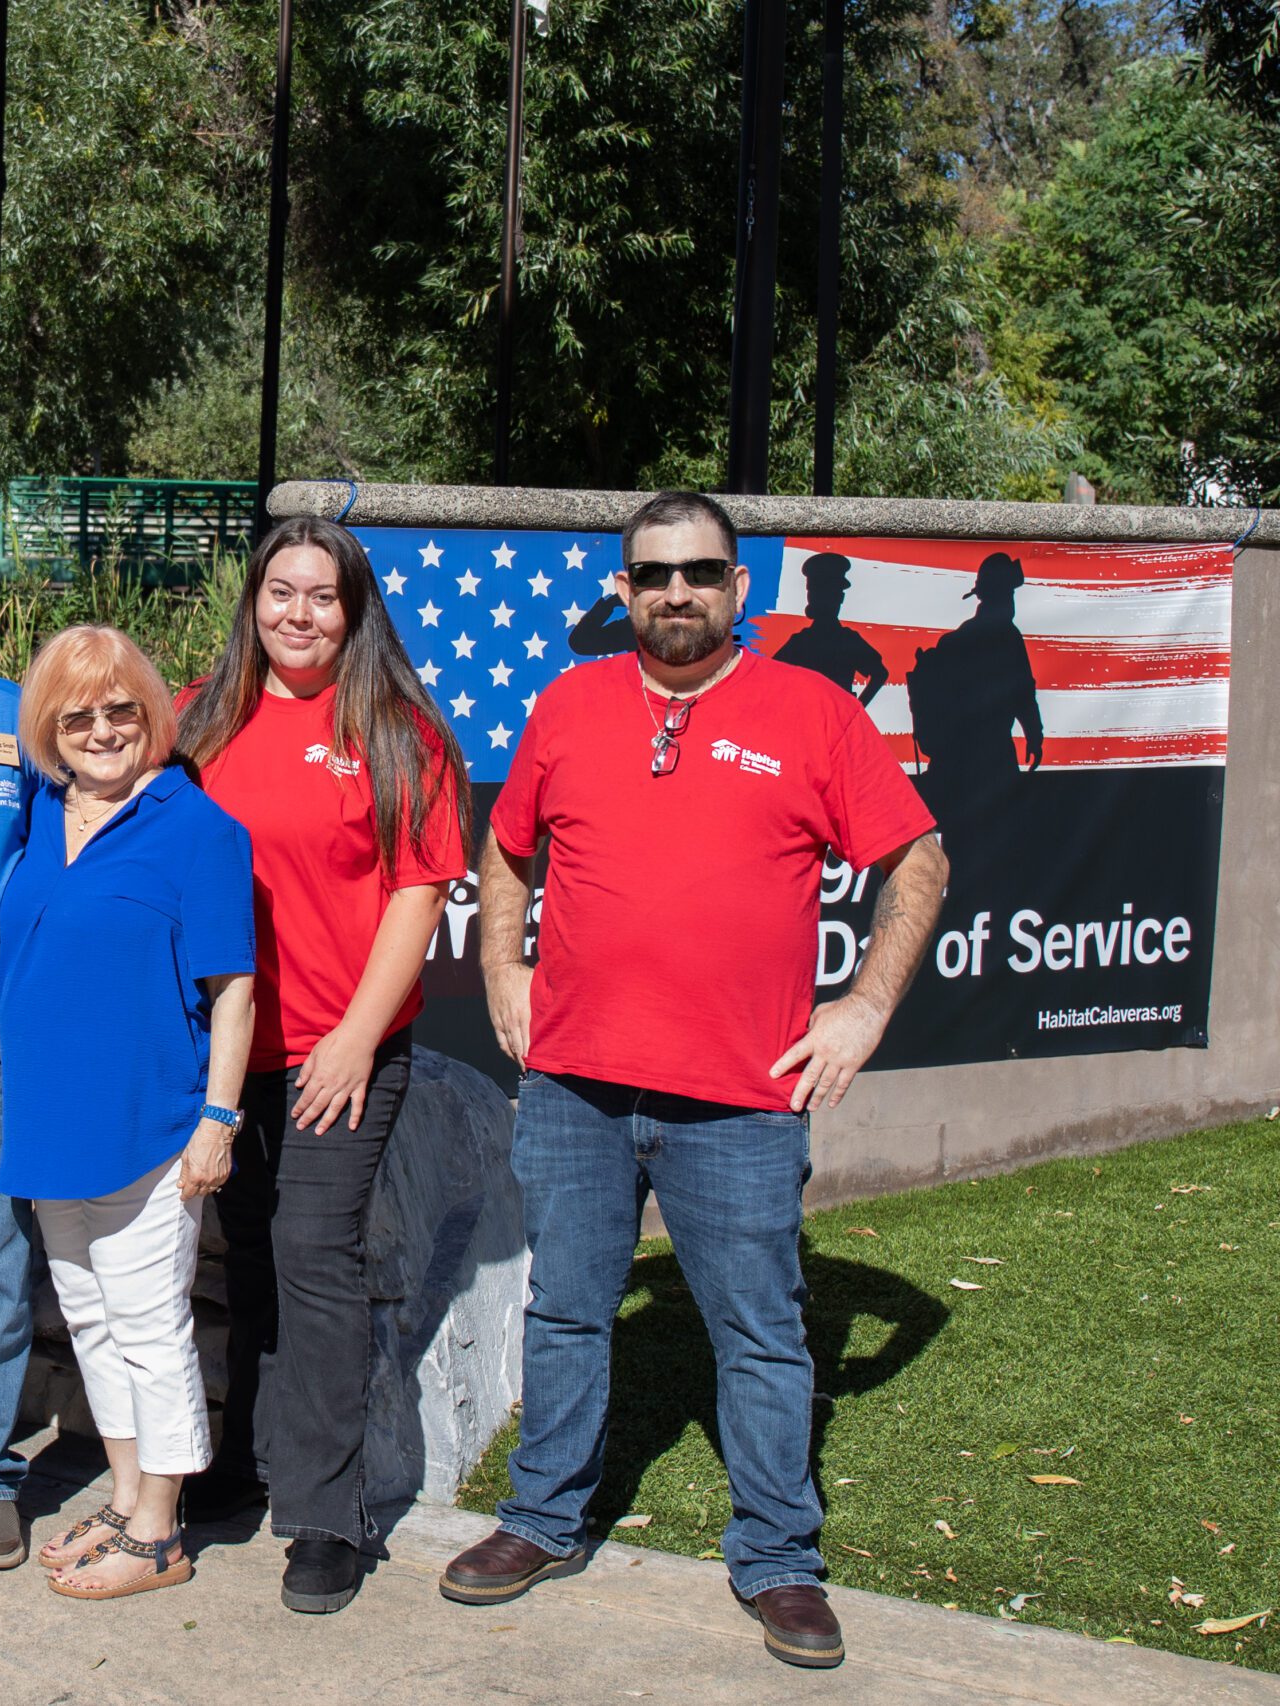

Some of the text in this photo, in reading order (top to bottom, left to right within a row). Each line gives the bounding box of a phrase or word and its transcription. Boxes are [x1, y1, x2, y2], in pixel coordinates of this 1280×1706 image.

[741, 749, 781, 770] Habitat
[936, 911, 991, 978] of
[1007, 903, 1191, 973] Service
[1038, 1004, 1182, 1029] HabitatCalaveras.org
